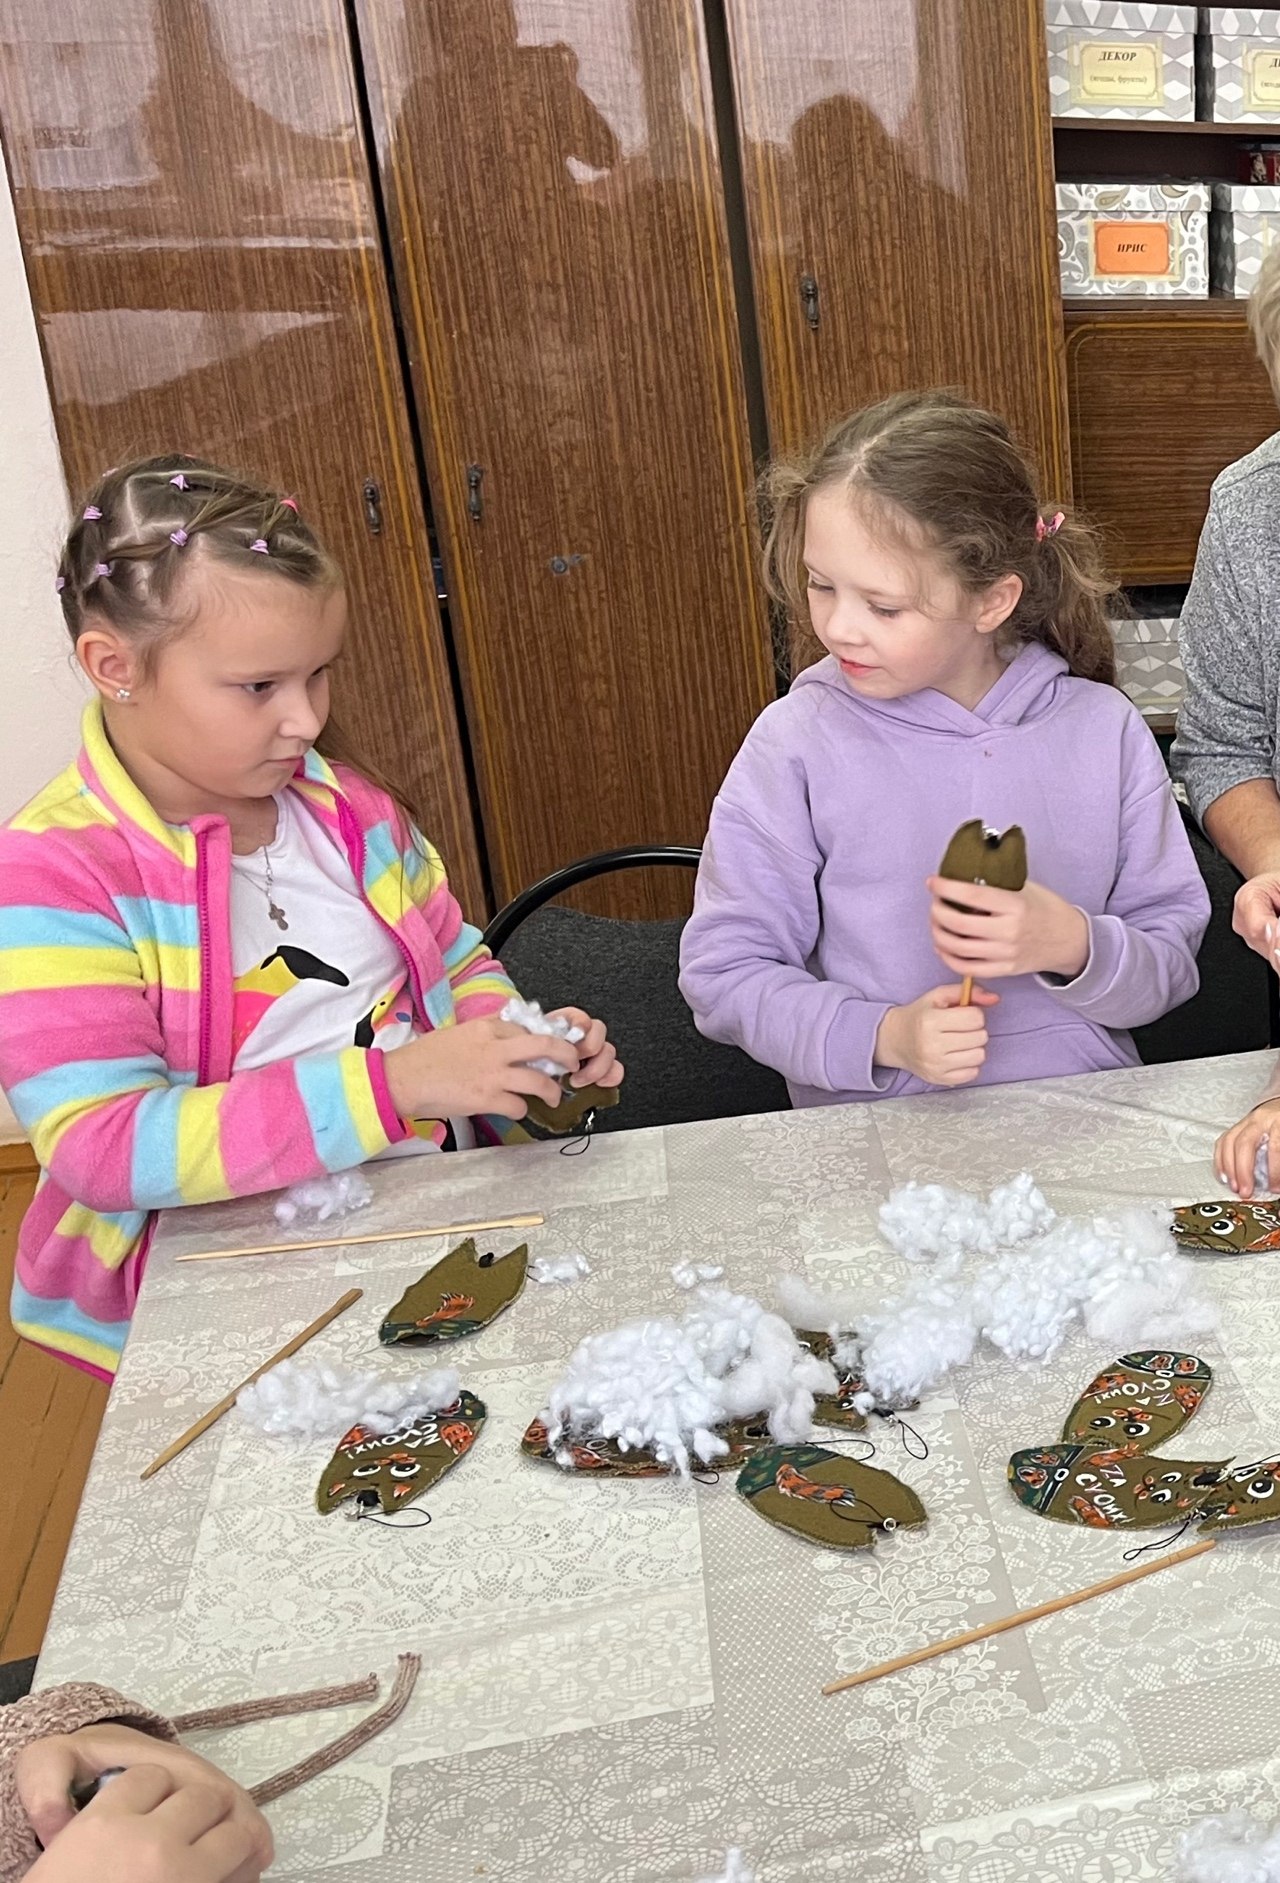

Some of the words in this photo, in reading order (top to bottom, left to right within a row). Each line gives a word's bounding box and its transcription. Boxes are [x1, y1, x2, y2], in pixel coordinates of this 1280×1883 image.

[1098, 51, 1137, 62] ДЕКОР
[1117, 243, 1148, 253] ИРИС
[1134, 1393, 1175, 1407] ZA
[405, 1431, 442, 1449] ZA
